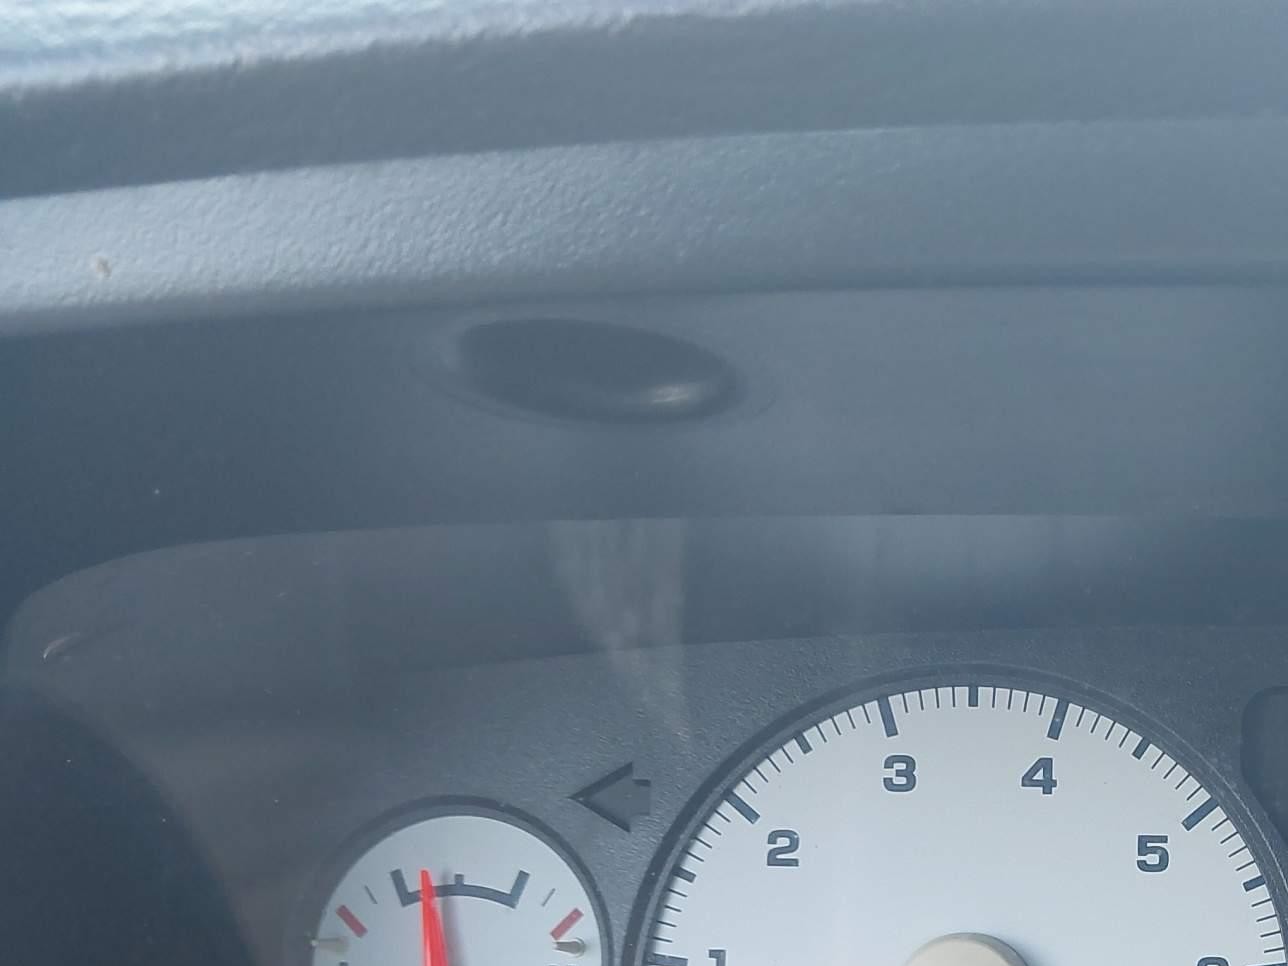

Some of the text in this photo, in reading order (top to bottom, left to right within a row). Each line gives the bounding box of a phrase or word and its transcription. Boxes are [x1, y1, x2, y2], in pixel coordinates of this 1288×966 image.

[883, 755, 917, 793] 3
[1022, 757, 1057, 794] 4
[767, 830, 799, 867] 2
[1137, 835, 1169, 872] 5
